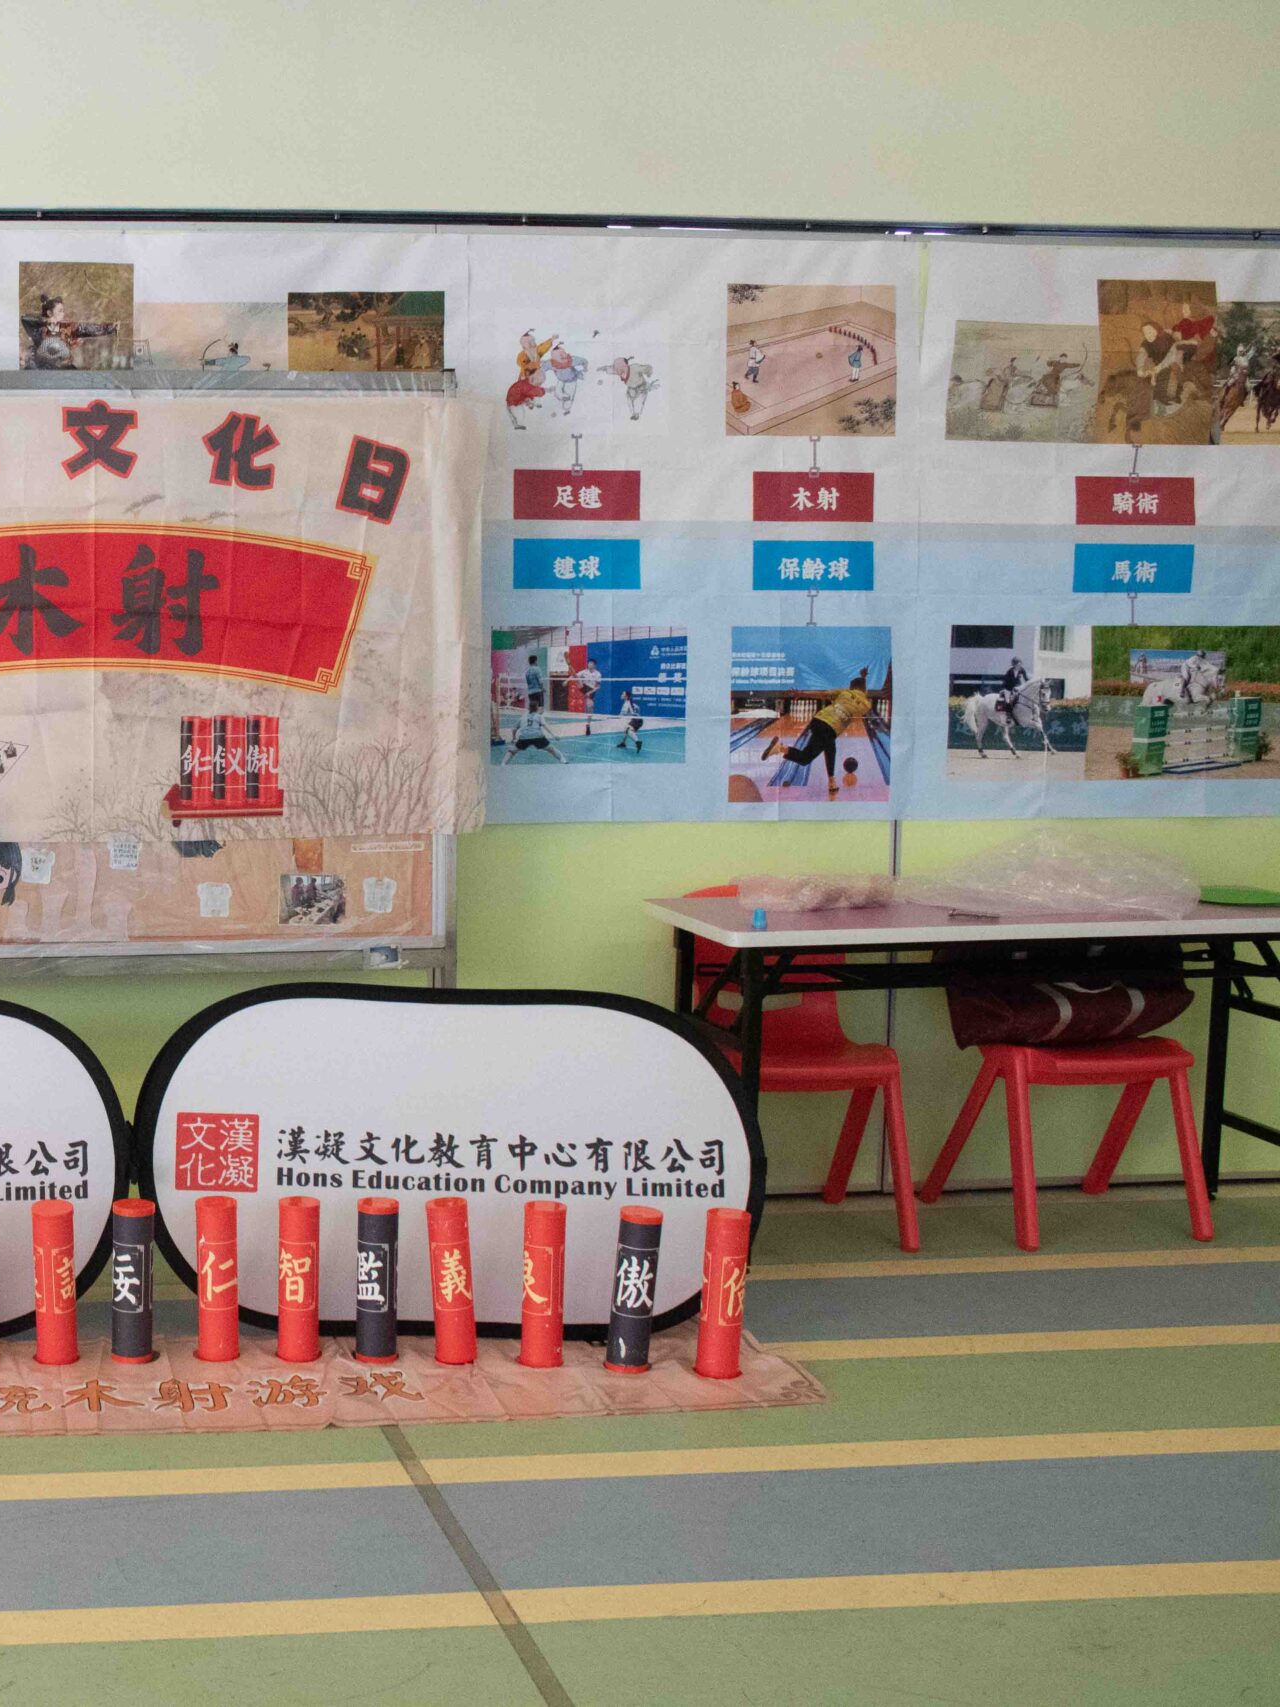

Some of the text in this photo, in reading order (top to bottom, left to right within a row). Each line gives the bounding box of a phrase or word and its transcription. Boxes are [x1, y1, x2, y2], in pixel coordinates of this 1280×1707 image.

[553, 485, 602, 508] 足毽
[790, 487, 840, 511] 木射
[1112, 492, 1159, 515] 騎術
[553, 556, 601, 580] 毽球
[778, 557, 850, 580] 保齡球
[1112, 560, 1158, 583] 馬術
[276, 1126, 725, 1176] 漢凝文化教育中心有限公司
[277, 1167, 725, 1200] Hons Education Company Limited
[201, 1251, 238, 1302] 仁
[279, 1248, 312, 1303] 智
[439, 1248, 473, 1303] 義
[616, 1256, 654, 1309] 傲
